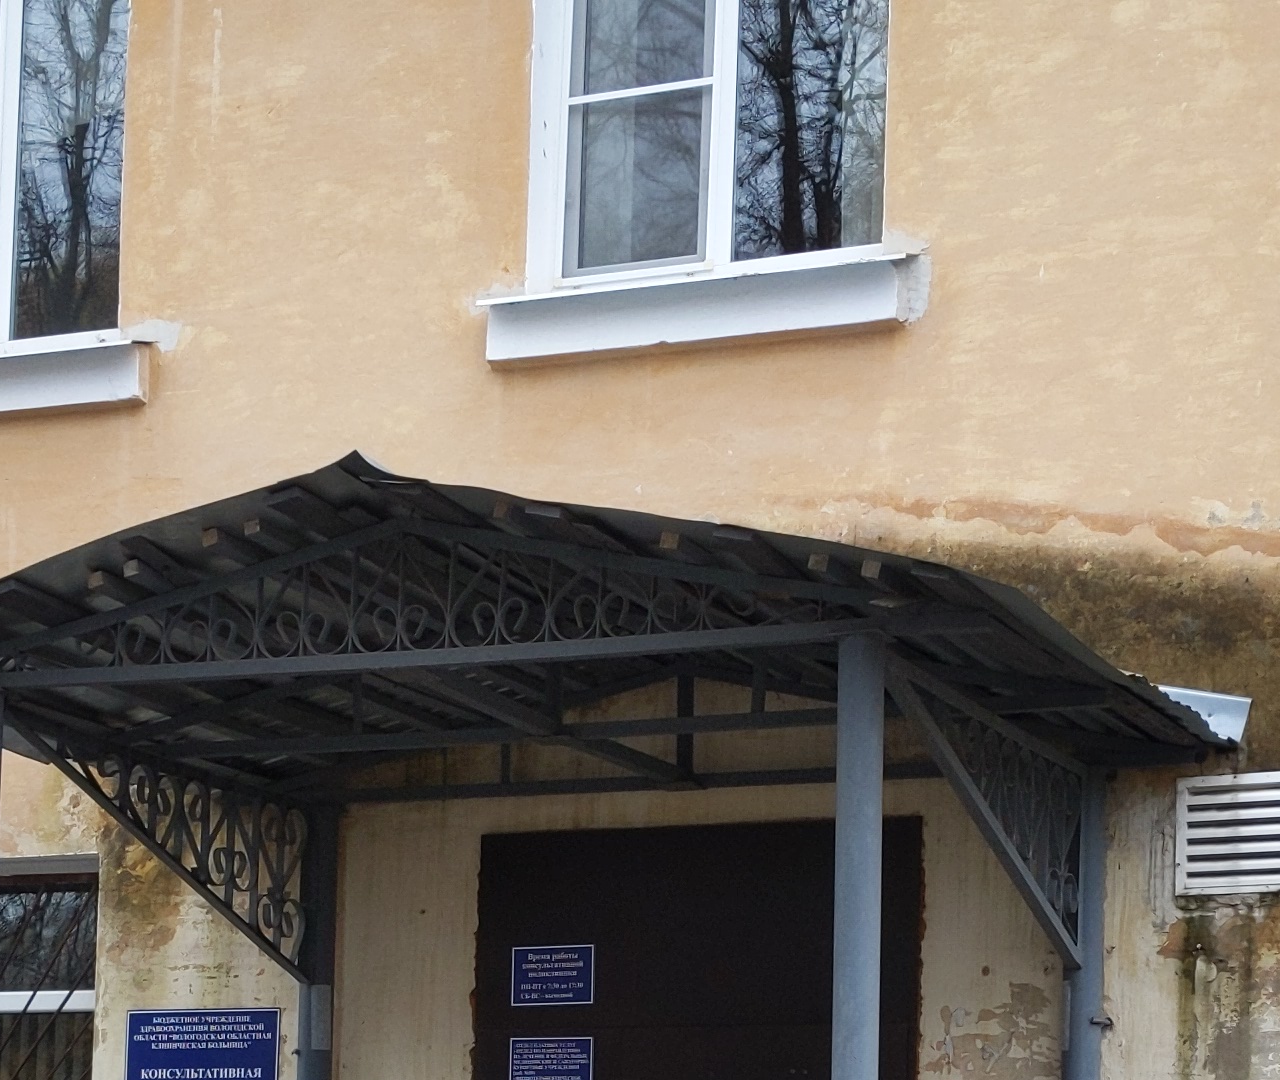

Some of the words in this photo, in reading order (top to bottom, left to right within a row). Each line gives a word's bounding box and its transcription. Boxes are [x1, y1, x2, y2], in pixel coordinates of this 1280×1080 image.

[152, 1016, 200, 1024] БЮДЖЕТНОЕ
[201, 1015, 252, 1023] УЧРЕЖДЕНИЕ
[140, 1025, 209, 1033] ЗДРАВООХРАНЕНИЯ
[209, 1022, 265, 1032] ВОЛОГОДСКОЙ
[133, 1034, 168, 1042] ОБЛАСТИ
[226, 1032, 272, 1040] ОБЛАСТНАЯ
[151, 1042, 207, 1050] КЛИНИЧЕСКАЯ
[140, 1067, 262, 1080] КОНСУЛЬТАТИВНАЯ
